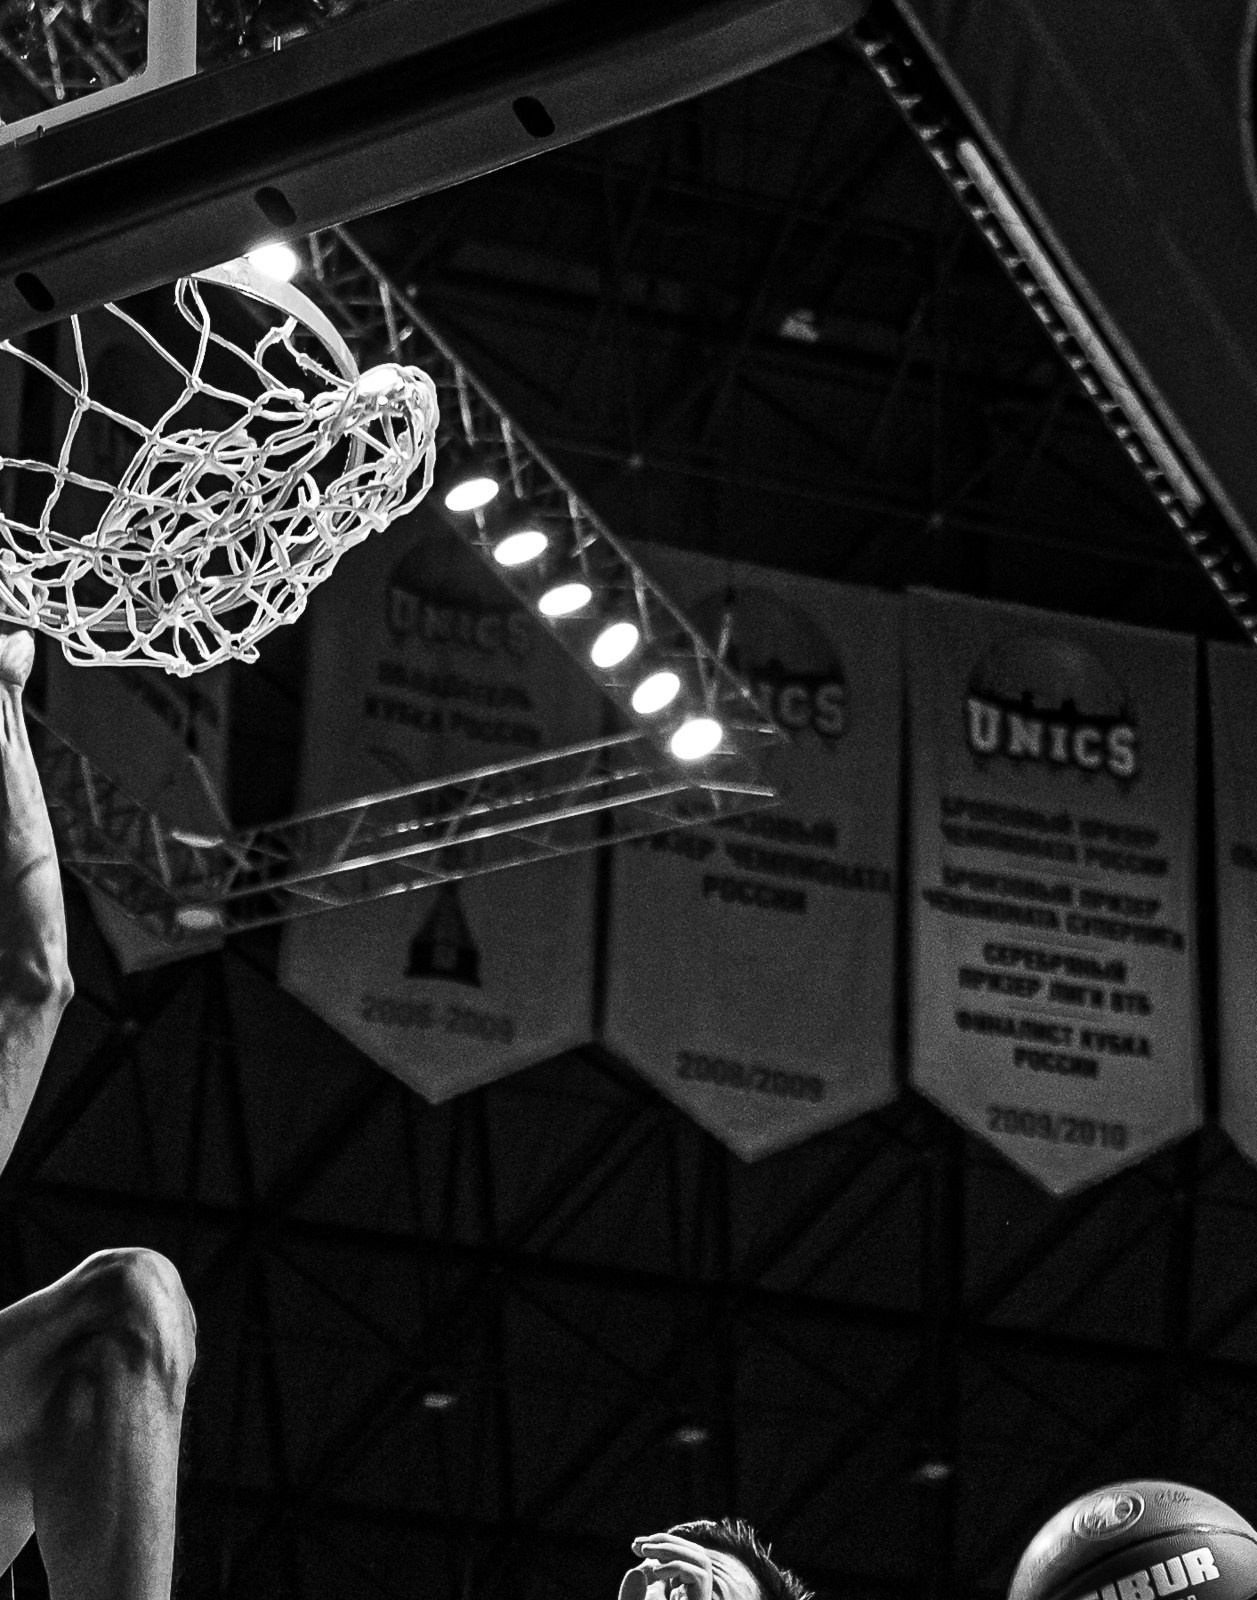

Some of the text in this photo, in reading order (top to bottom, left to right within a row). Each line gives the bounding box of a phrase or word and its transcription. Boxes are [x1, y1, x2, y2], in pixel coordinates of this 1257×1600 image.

[392, 587, 530, 652] UNICS
[757, 682, 845, 734] ICS
[967, 698, 1139, 777] UNICS
[701, 872, 809, 914] РОССИИ
[982, 941, 1128, 984] СЕРЕБРЯНЫЙ
[958, 965, 1155, 1017] ПРИЗЕР ЛИГИ ВТБ
[954, 1009, 1154, 1060] ФИНАЛИСТ КУБКА
[1012, 1044, 1102, 1081] РОССИИ
[986, 1101, 1130, 1152] 2009/2010
